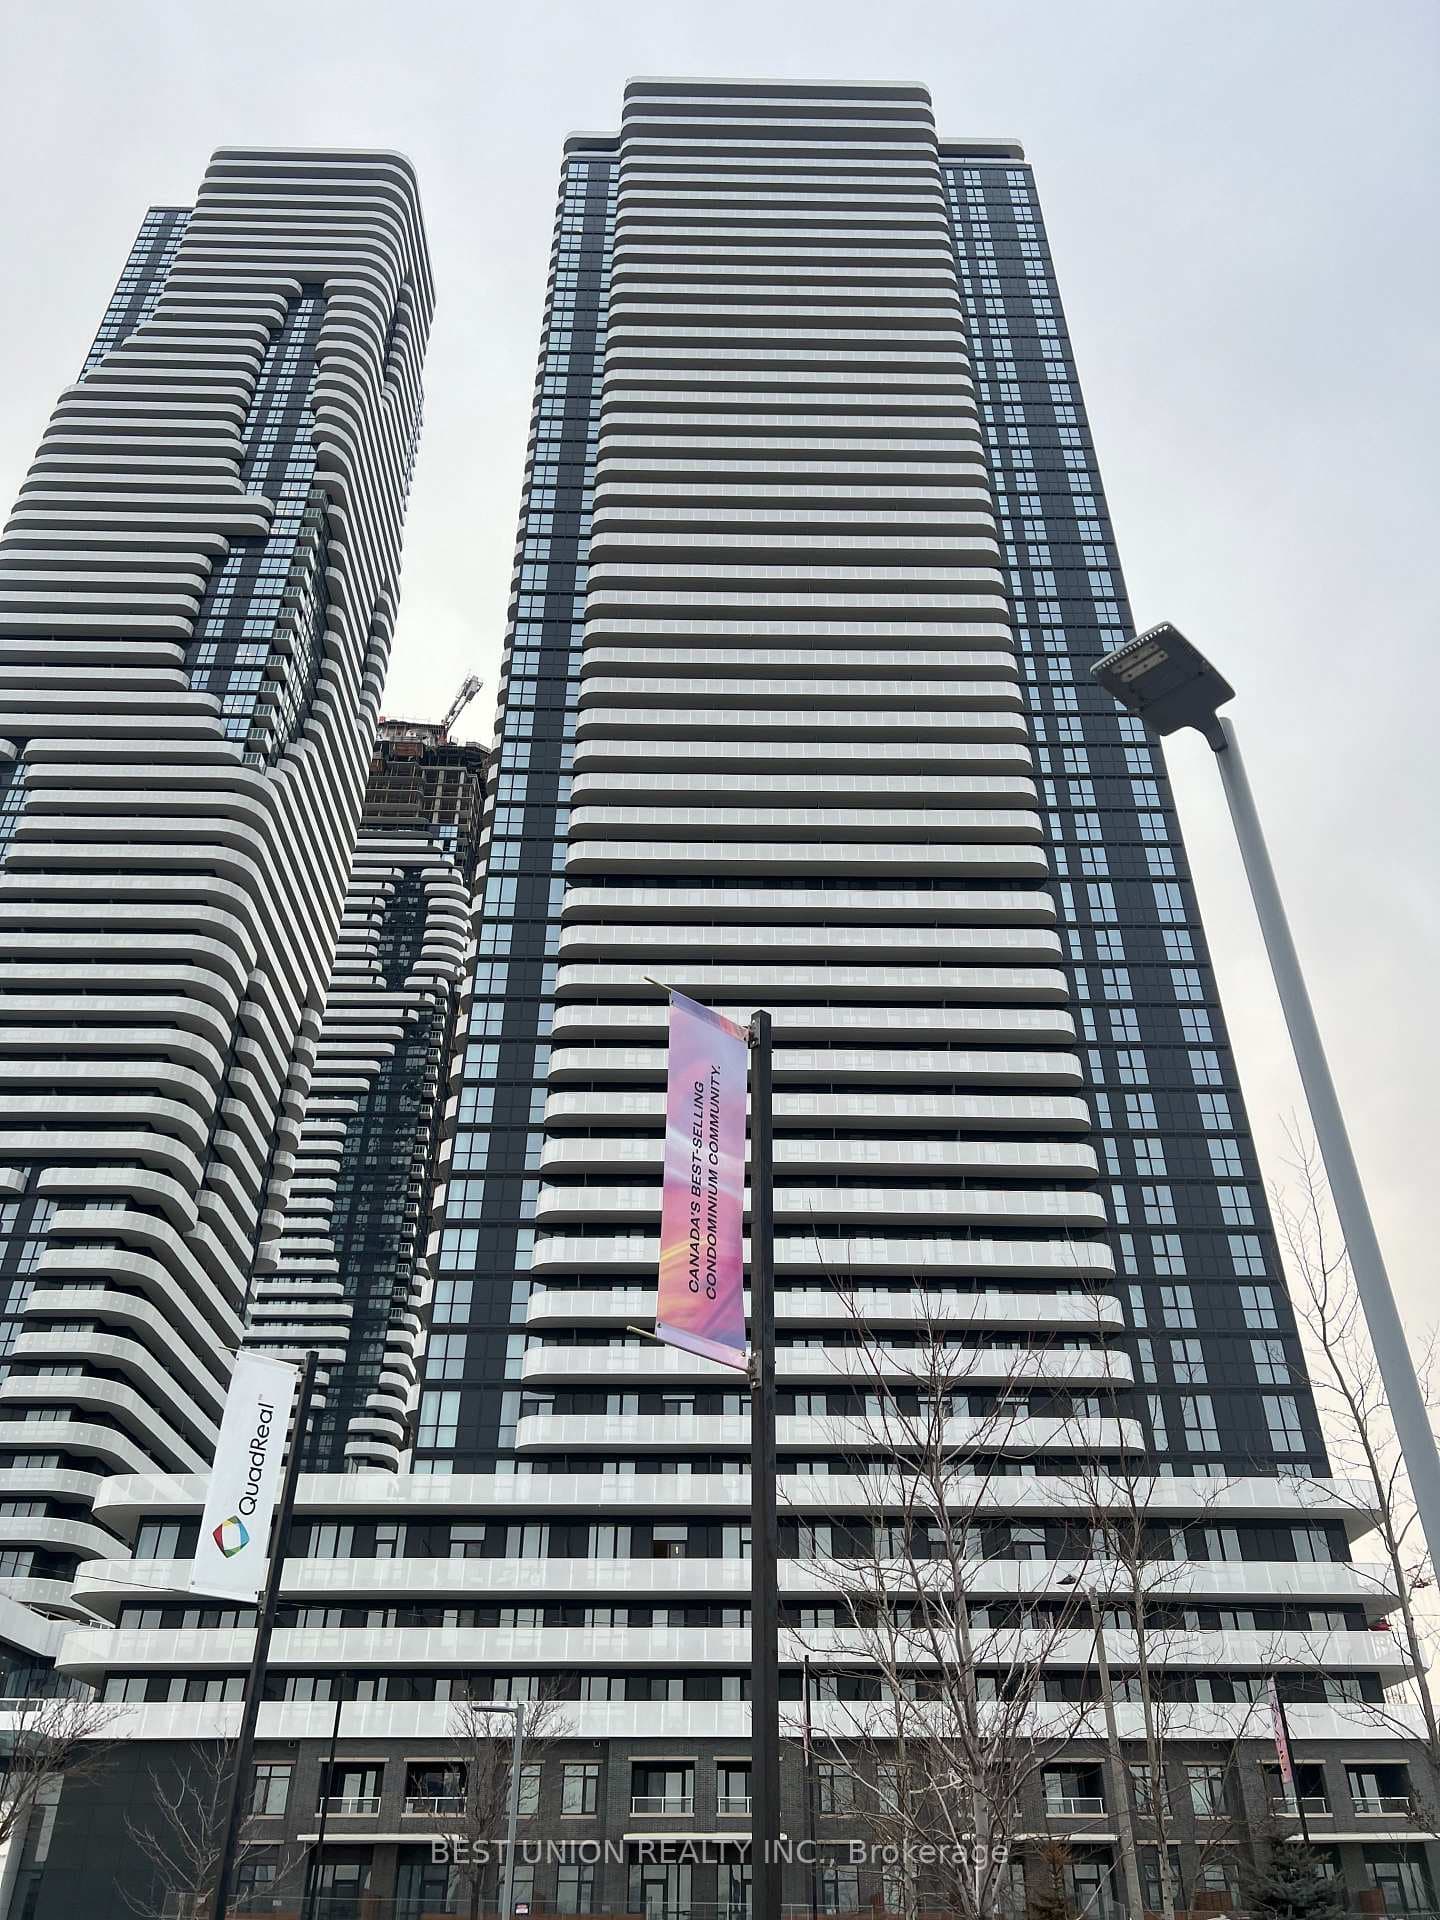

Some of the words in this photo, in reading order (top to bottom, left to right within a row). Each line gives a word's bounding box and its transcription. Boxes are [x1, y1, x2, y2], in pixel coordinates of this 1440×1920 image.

[691, 1081, 704, 1198] BEST-SELLING
[708, 1065, 721, 1166] COMMUNITY.
[688, 1201, 701, 1293] CANADA'S
[706, 1168, 719, 1300] CONDOMINIUM
[238, 1402, 274, 1516] QuadReal
